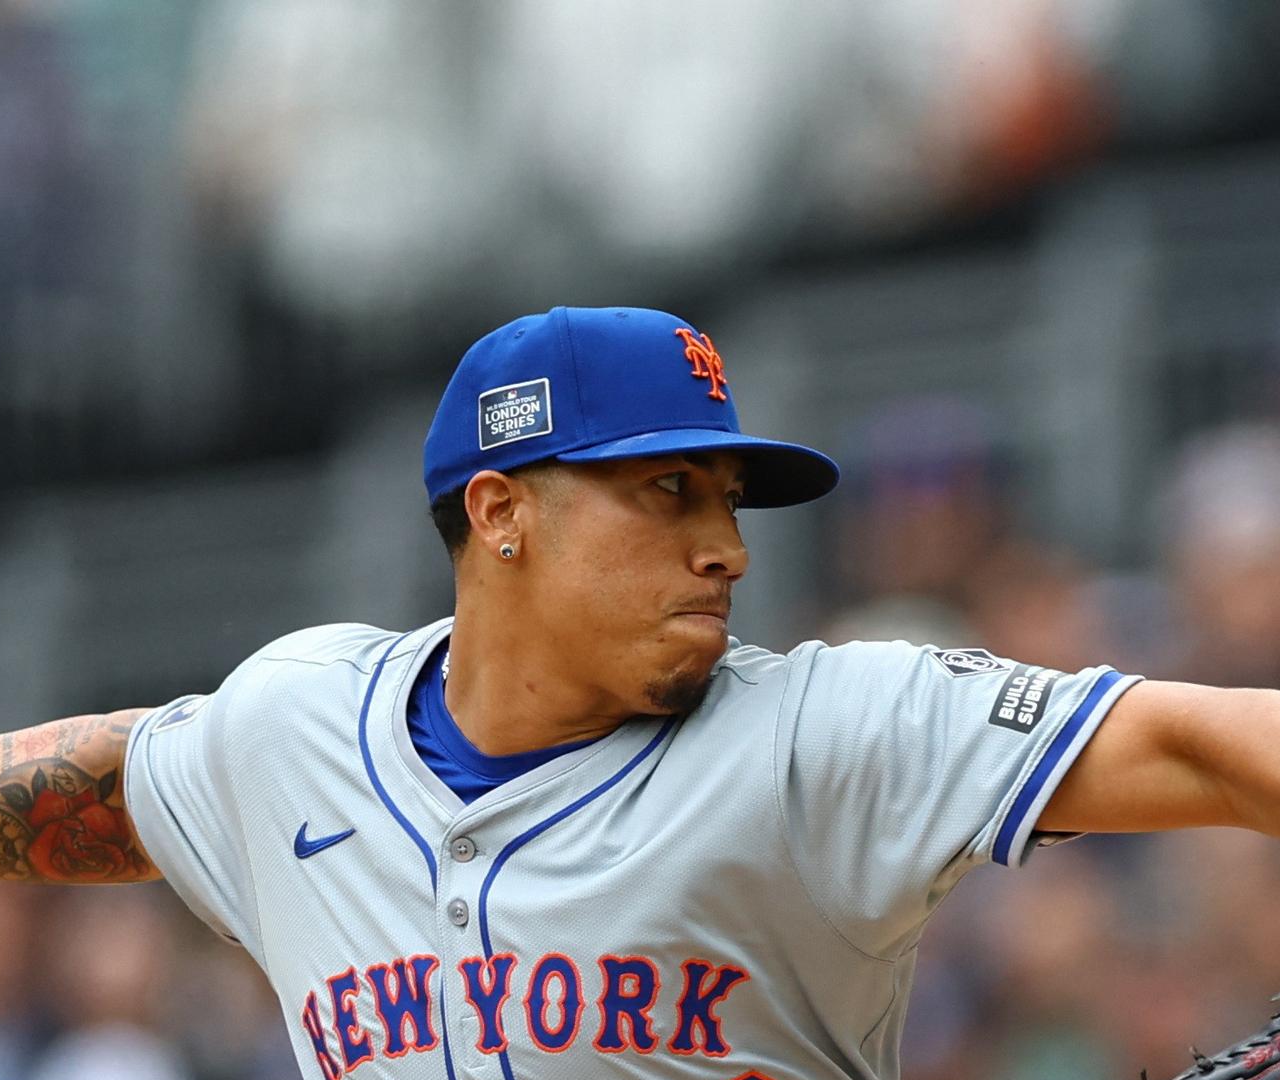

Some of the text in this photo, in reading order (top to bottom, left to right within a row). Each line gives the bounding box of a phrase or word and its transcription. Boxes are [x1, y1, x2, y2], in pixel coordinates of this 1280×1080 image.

[485, 401, 541, 425] LONDON
[498, 398, 520, 409] WORLD
[491, 414, 536, 435] SERIES
[504, 429, 521, 439] 2024
[998, 676, 1029, 721] BUILD
[456, 951, 752, 1057] YORK
